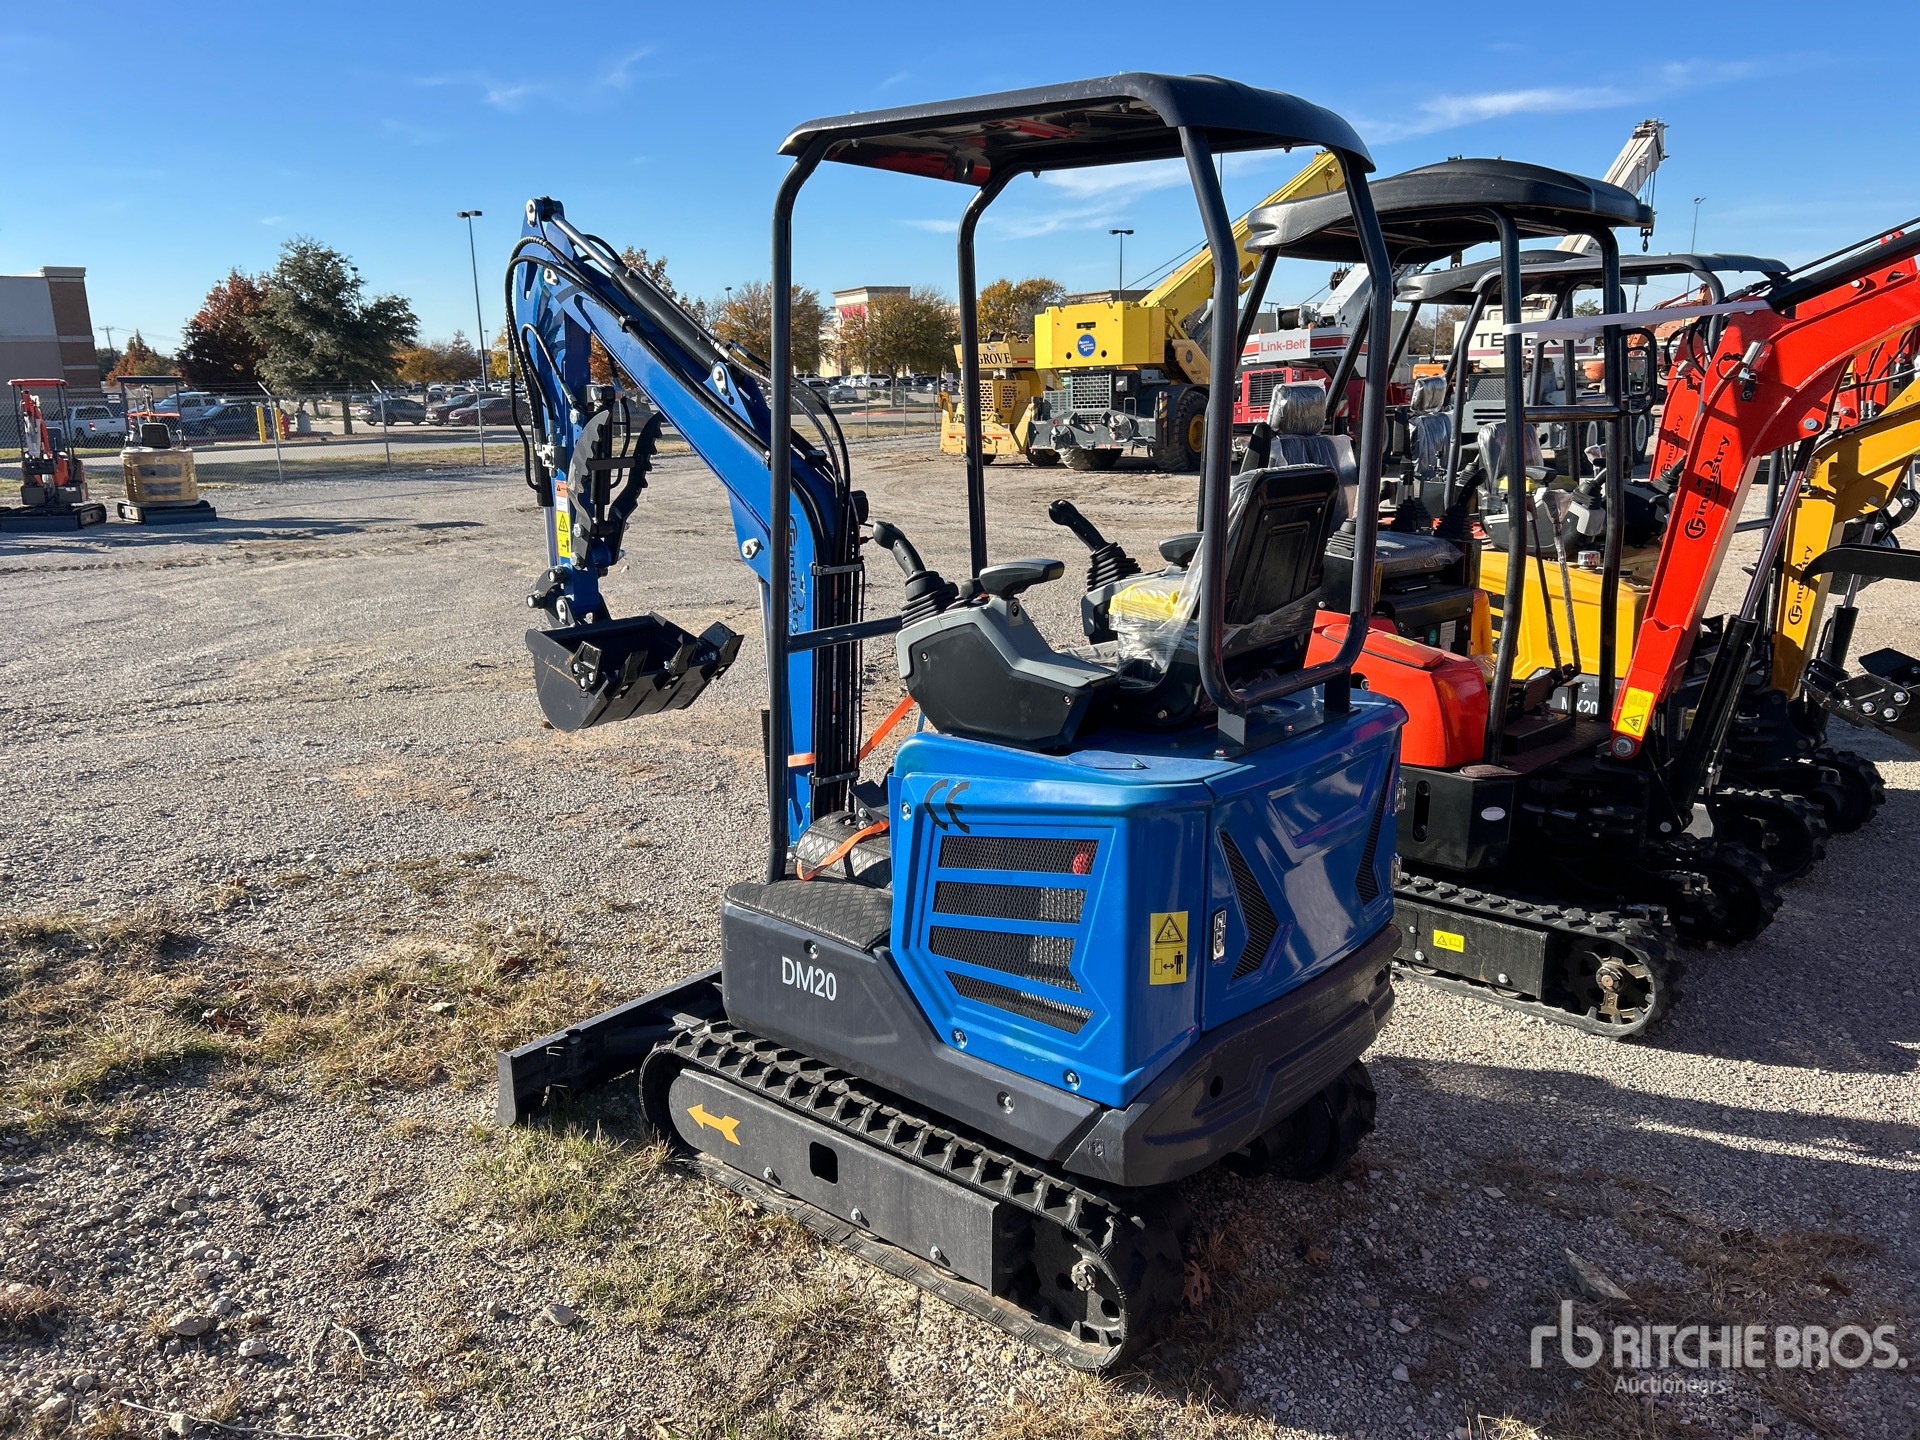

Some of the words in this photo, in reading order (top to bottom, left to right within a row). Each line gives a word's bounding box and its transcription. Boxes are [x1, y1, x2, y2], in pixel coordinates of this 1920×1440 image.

[1260, 339, 1306, 352] Link-Belt
[1476, 333, 1559, 348] TEE
[782, 956, 837, 1001] DM20
